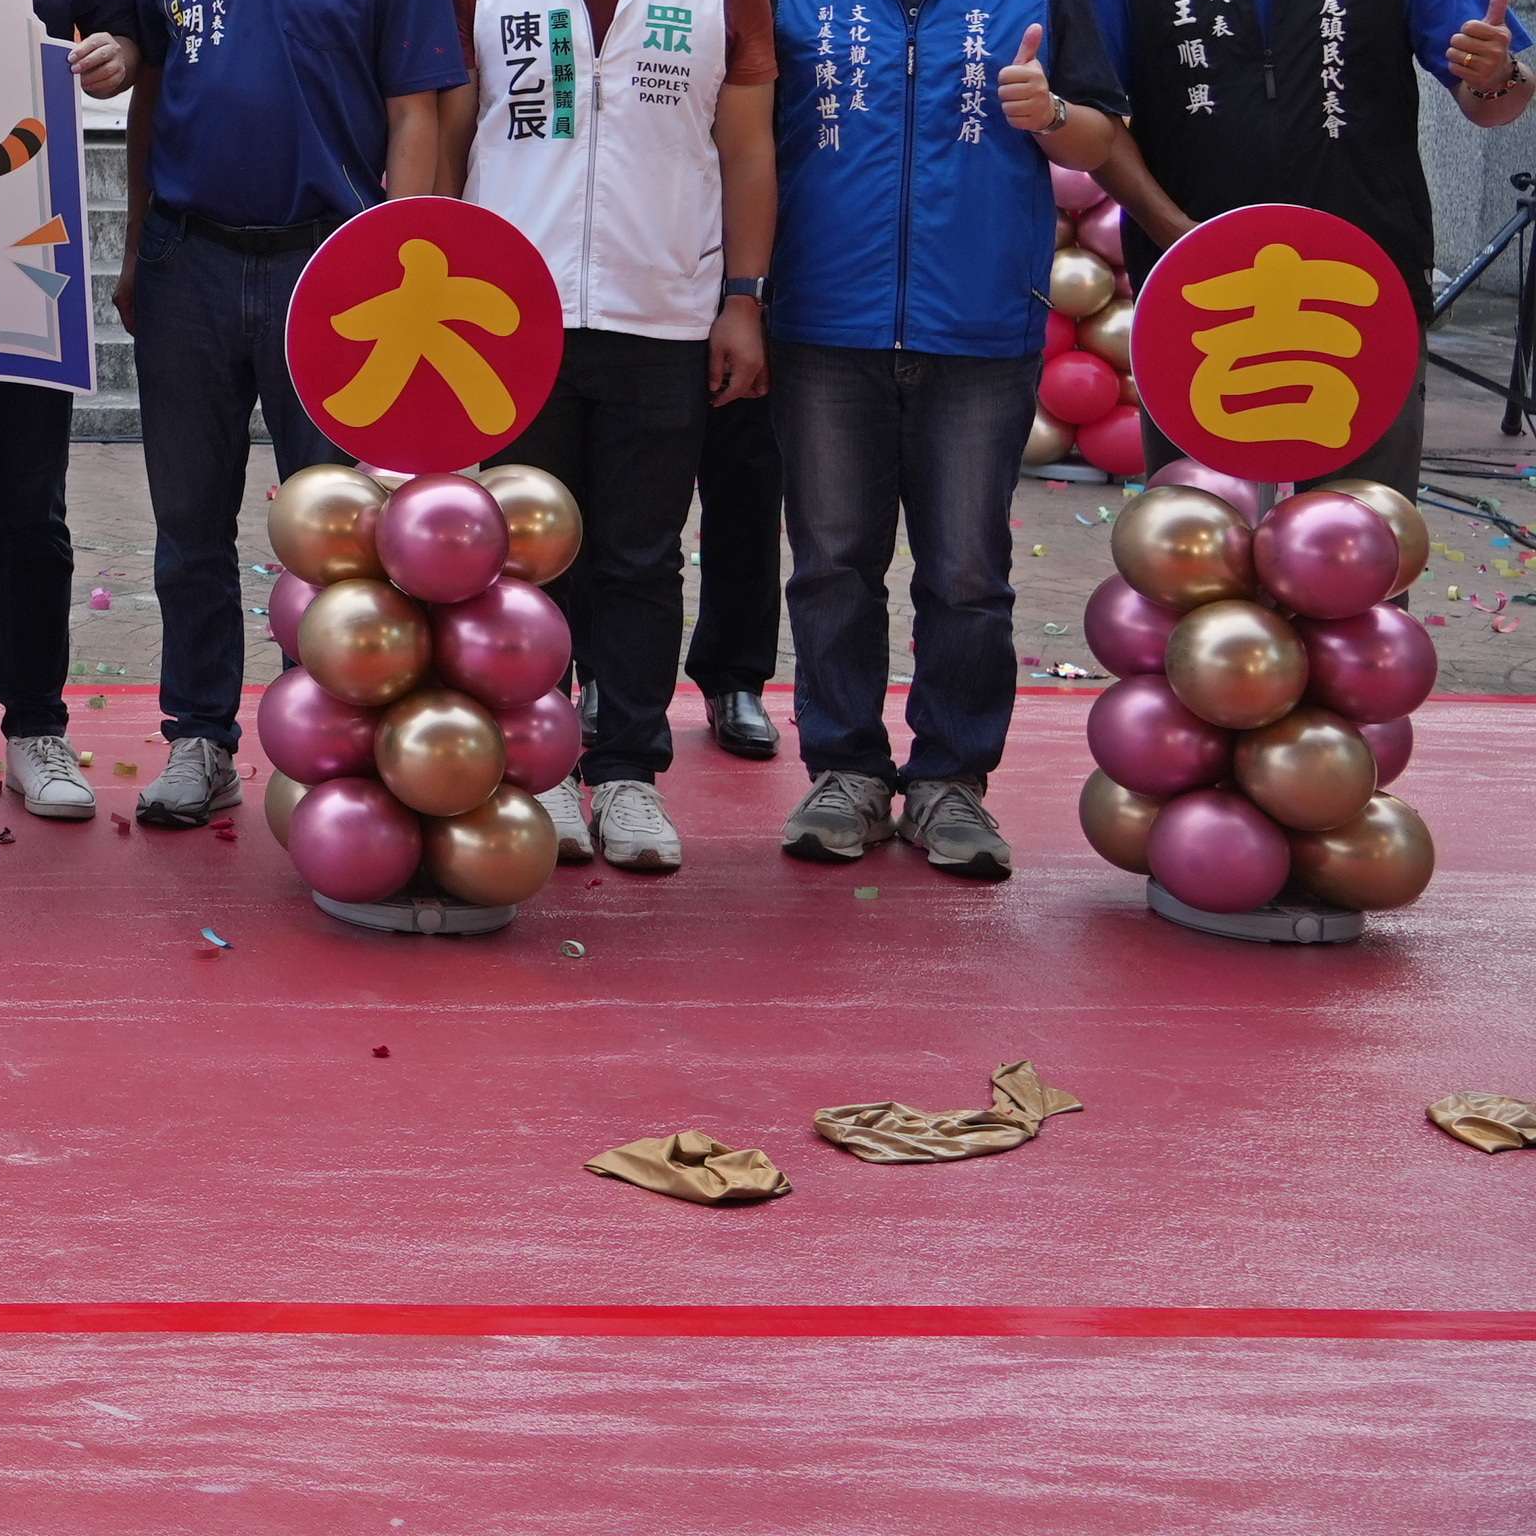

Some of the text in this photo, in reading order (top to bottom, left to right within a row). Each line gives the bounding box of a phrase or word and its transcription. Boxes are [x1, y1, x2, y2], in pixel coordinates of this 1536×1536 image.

[500, 11, 548, 141] 陳乙辰
[551, 11, 575, 136] 雲林縣議員
[631, 76, 690, 93] PEOPLE'S
[636, 61, 691, 78] TAIWAN
[639, 92, 681, 107] PARTY
[815, 4, 843, 152] 副處長 陳世訓
[848, 4, 871, 112] 文化觀光處
[957, 8, 993, 145] 雲林縣政府
[321, 238, 521, 436] 大
[1182, 243, 1381, 450] 吉
